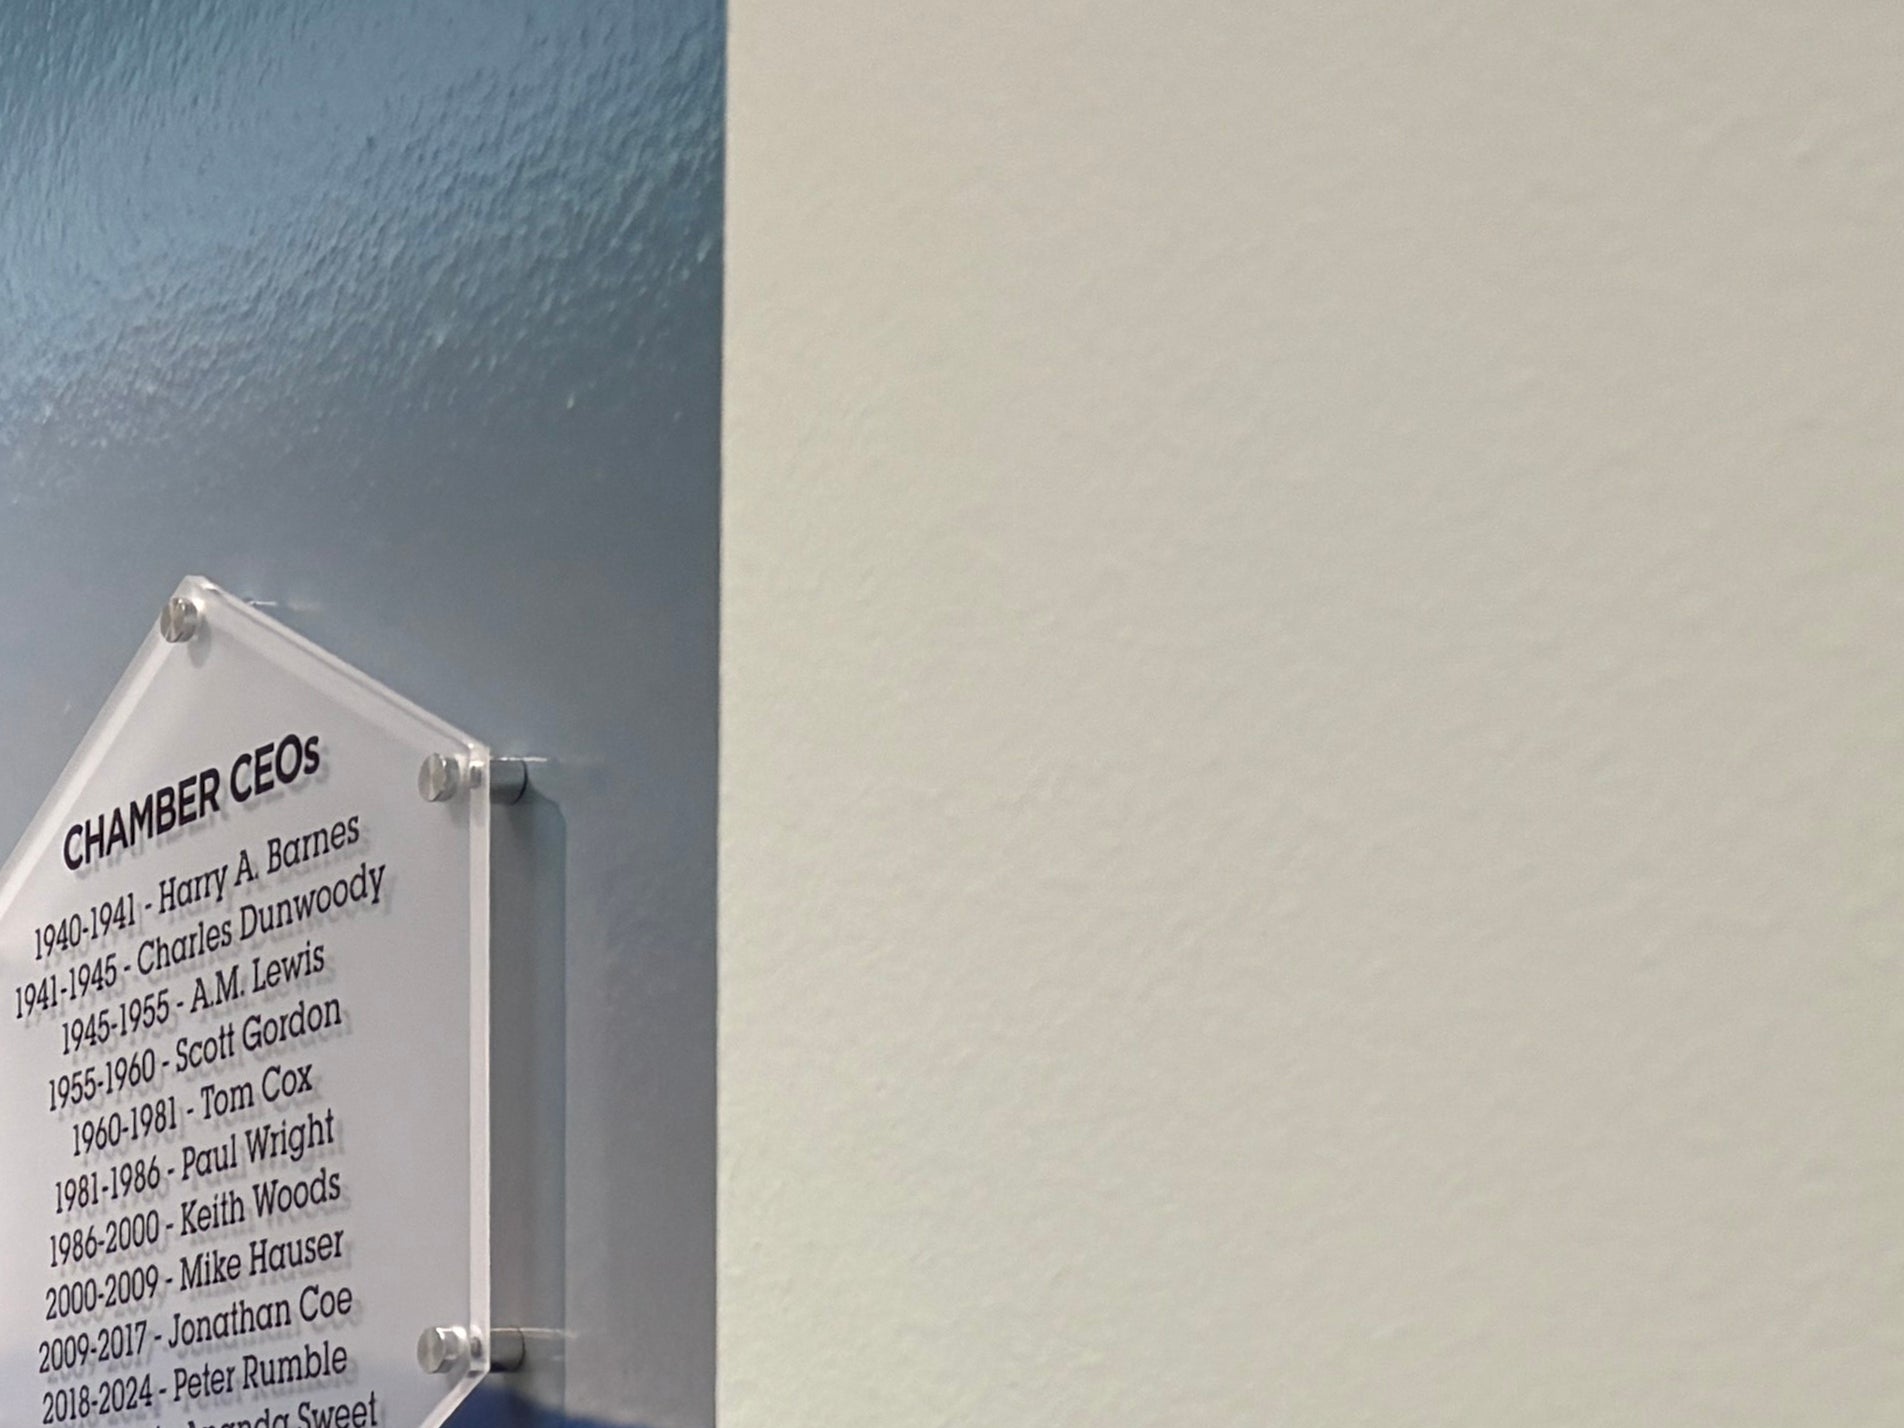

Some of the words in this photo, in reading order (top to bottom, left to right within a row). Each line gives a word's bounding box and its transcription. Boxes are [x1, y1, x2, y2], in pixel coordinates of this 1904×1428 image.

[63, 764, 220, 872] CHAMBER
[230, 731, 320, 805] CEOs
[15, 952, 116, 1020] 1941-1945
[137, 920, 232, 978] Charles
[240, 862, 385, 942] Dunwoody
[35, 891, 135, 961] 1940-1941
[158, 865, 228, 915] Harry
[234, 847, 258, 887] A.
[267, 815, 359, 875] Barnes
[62, 987, 169, 1055] 1945-1955
[190, 964, 244, 1014] A.M.
[252, 940, 324, 993] Lewis
[49, 1047, 154, 1112] 1955-1960
[175, 1021, 235, 1073] Scott
[242, 997, 341, 1053] Gordon
[55, 1154, 160, 1214] 1981-1986
[181, 1133, 237, 1181] Paul
[245, 1106, 334, 1165] Wright
[73, 1095, 175, 1157] 1960-1981
[200, 1081, 252, 1121] Tom
[262, 1063, 313, 1103] Cox
[49, 1208, 159, 1268] 1986-2000
[180, 1187, 245, 1237] Keith
[252, 1167, 340, 1219] Woods
[39, 1320, 146, 1373] 2009-2017
[168, 1297, 290, 1348] Jonathan
[299, 1284, 352, 1323] Coe
[45, 1263, 158, 1320] 2000-2009
[179, 1248, 240, 1291] Mike
[248, 1230, 343, 1277] Hauser
[42, 1372, 152, 1424] 2018-2024
[173, 1363, 234, 1402] Peter
[242, 1340, 347, 1390] Rumble
